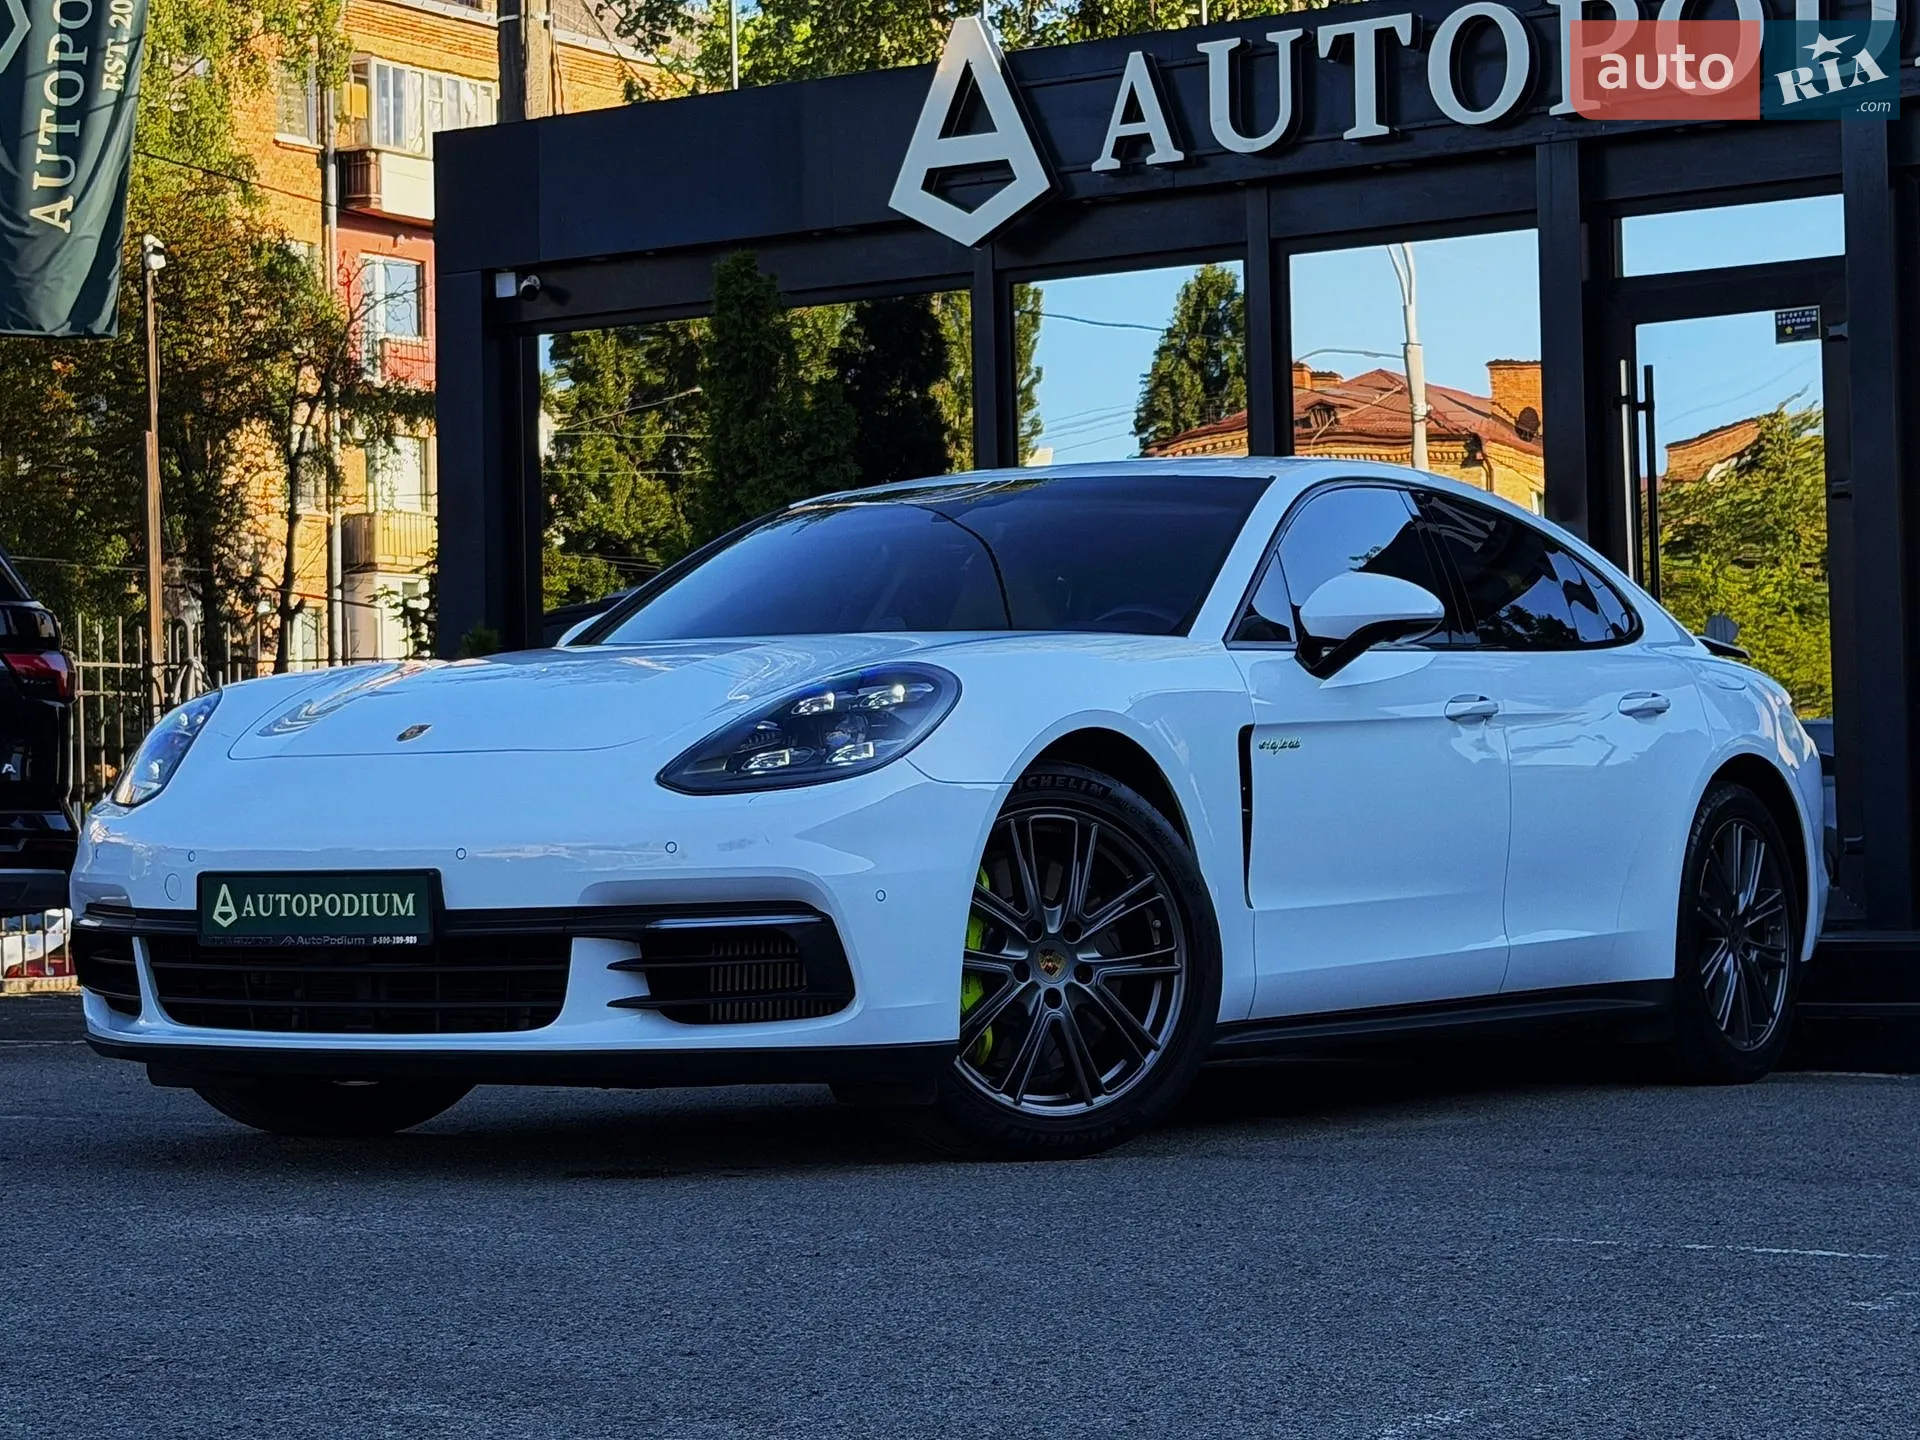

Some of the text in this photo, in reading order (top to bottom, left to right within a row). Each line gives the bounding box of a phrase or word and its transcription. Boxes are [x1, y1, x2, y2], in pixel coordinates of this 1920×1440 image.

[1091, 0, 1920, 172] AUTOPOD
[241, 893, 416, 917] AUTOPODIUM
[296, 935, 366, 946] AutoPodium
